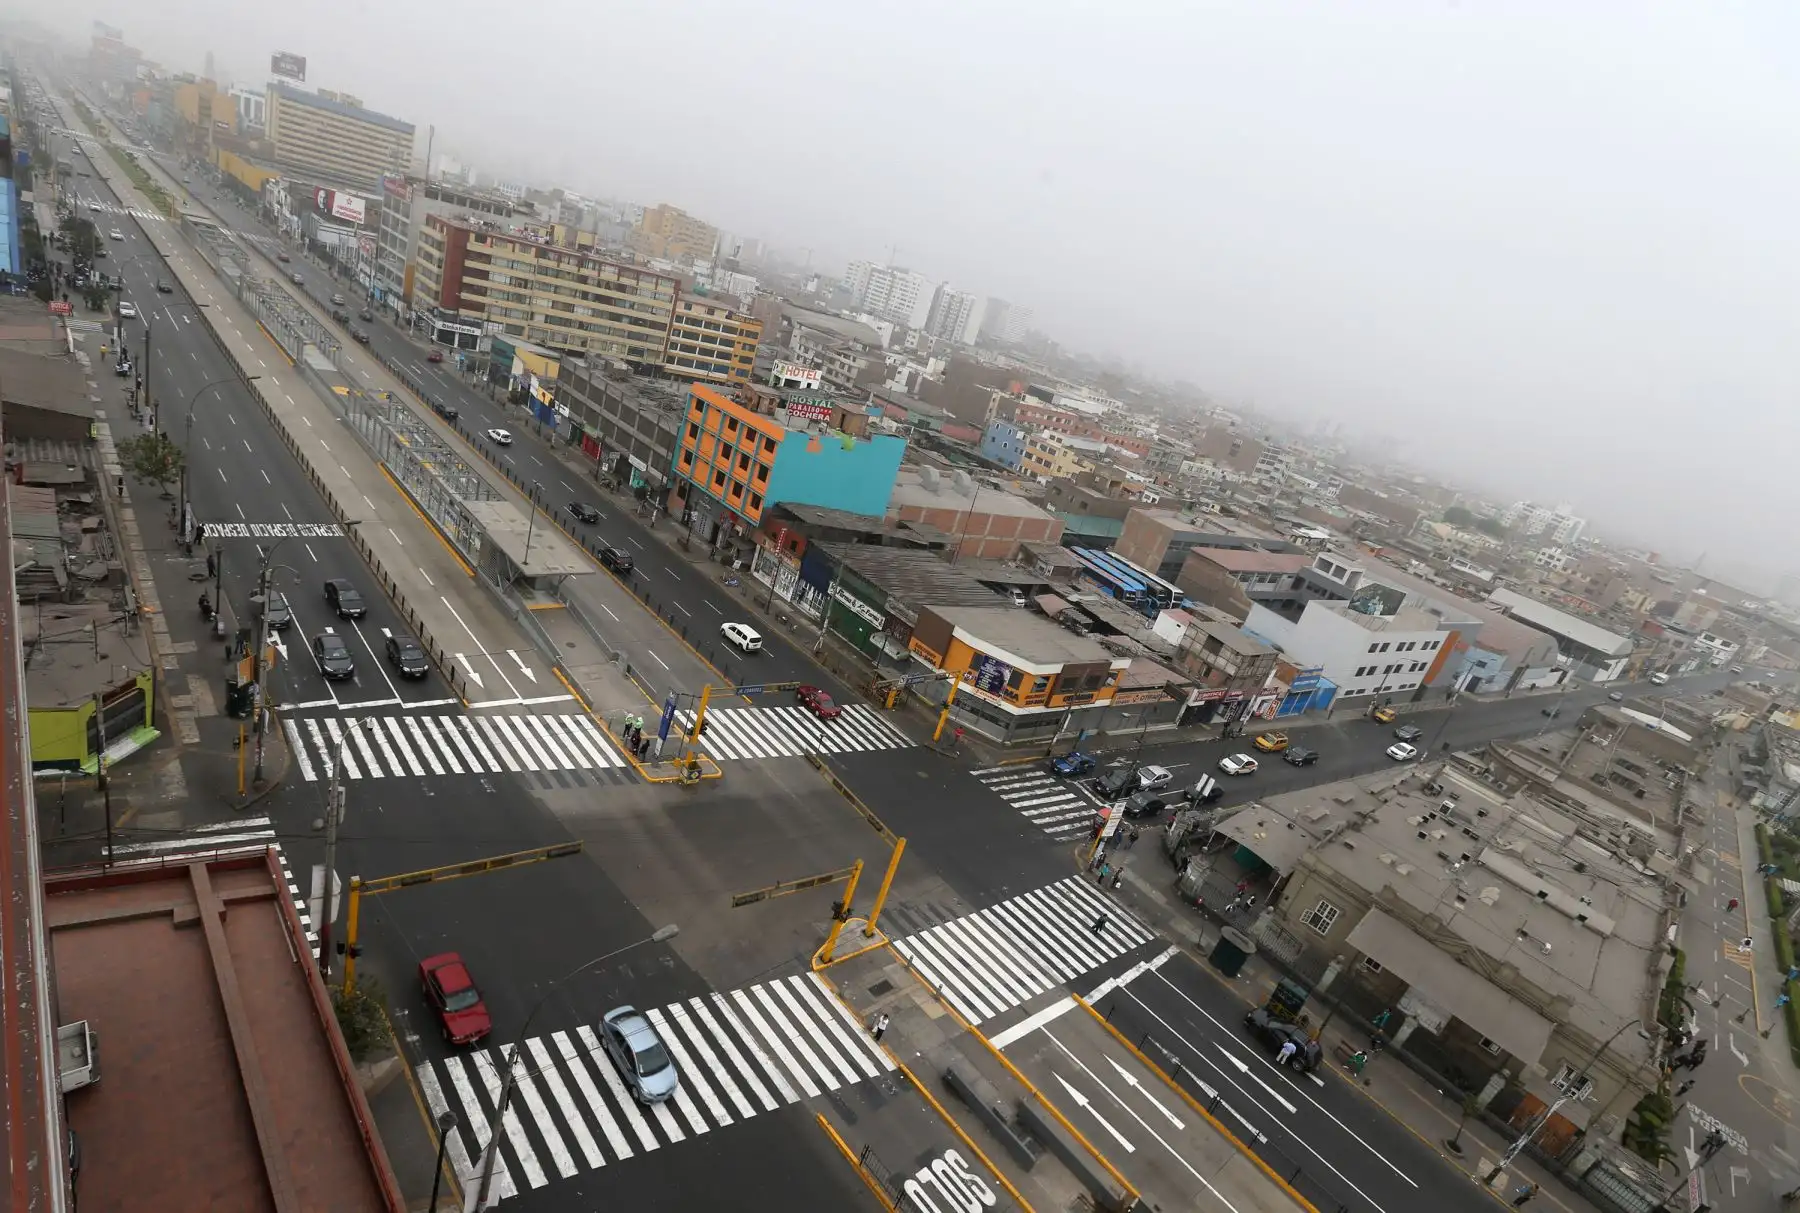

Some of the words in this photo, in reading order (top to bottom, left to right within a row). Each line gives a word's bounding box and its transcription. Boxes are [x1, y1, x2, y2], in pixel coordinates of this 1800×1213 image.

[785, 365, 819, 381] HOTEL
[791, 395, 833, 408] HOSTAL
[787, 409, 830, 421] COCHERA
[249, 523, 299, 537] DESPACIO
[297, 523, 344, 537] DESPACIO
[903, 1149, 996, 1213] SOLO
